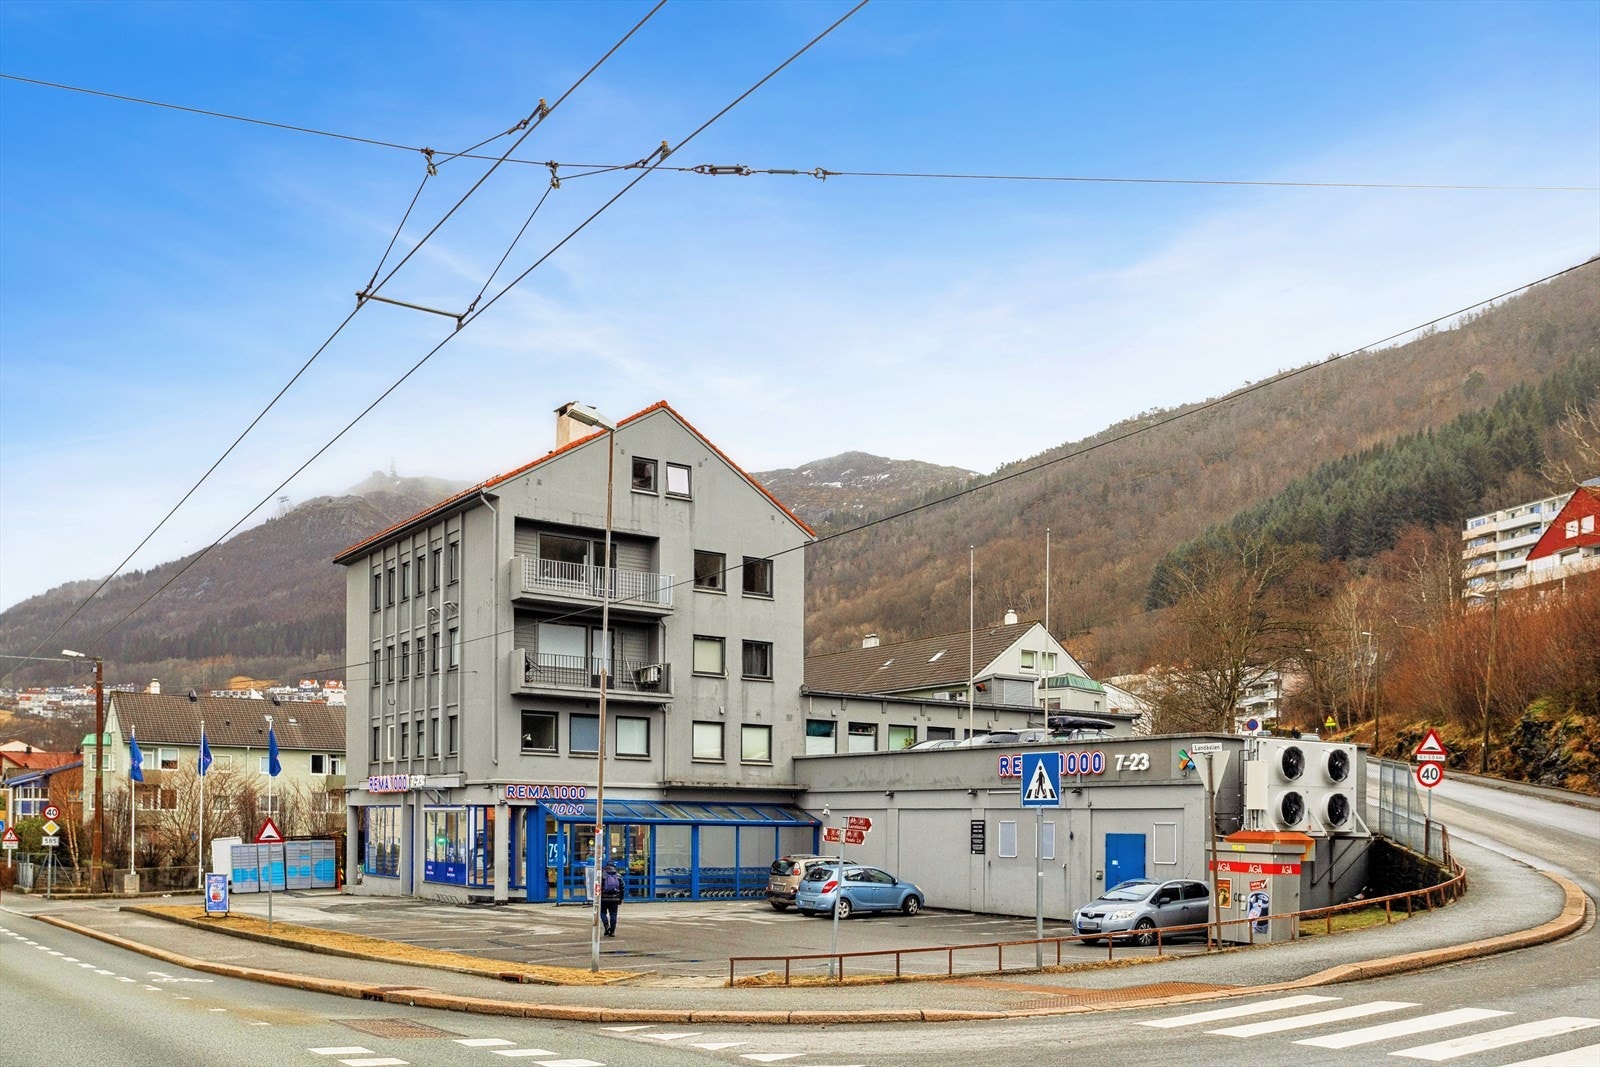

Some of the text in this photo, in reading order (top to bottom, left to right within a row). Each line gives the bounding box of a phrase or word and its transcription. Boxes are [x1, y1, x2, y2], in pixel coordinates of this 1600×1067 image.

[1115, 753, 1150, 771] 7-23
[1421, 767, 1439, 780] 40
[369, 775, 391, 792] REMA
[506, 784, 587, 800] REMA 1000
[46, 808, 57, 816] 40
[1217, 862, 1293, 875] AGA AGA AGA
